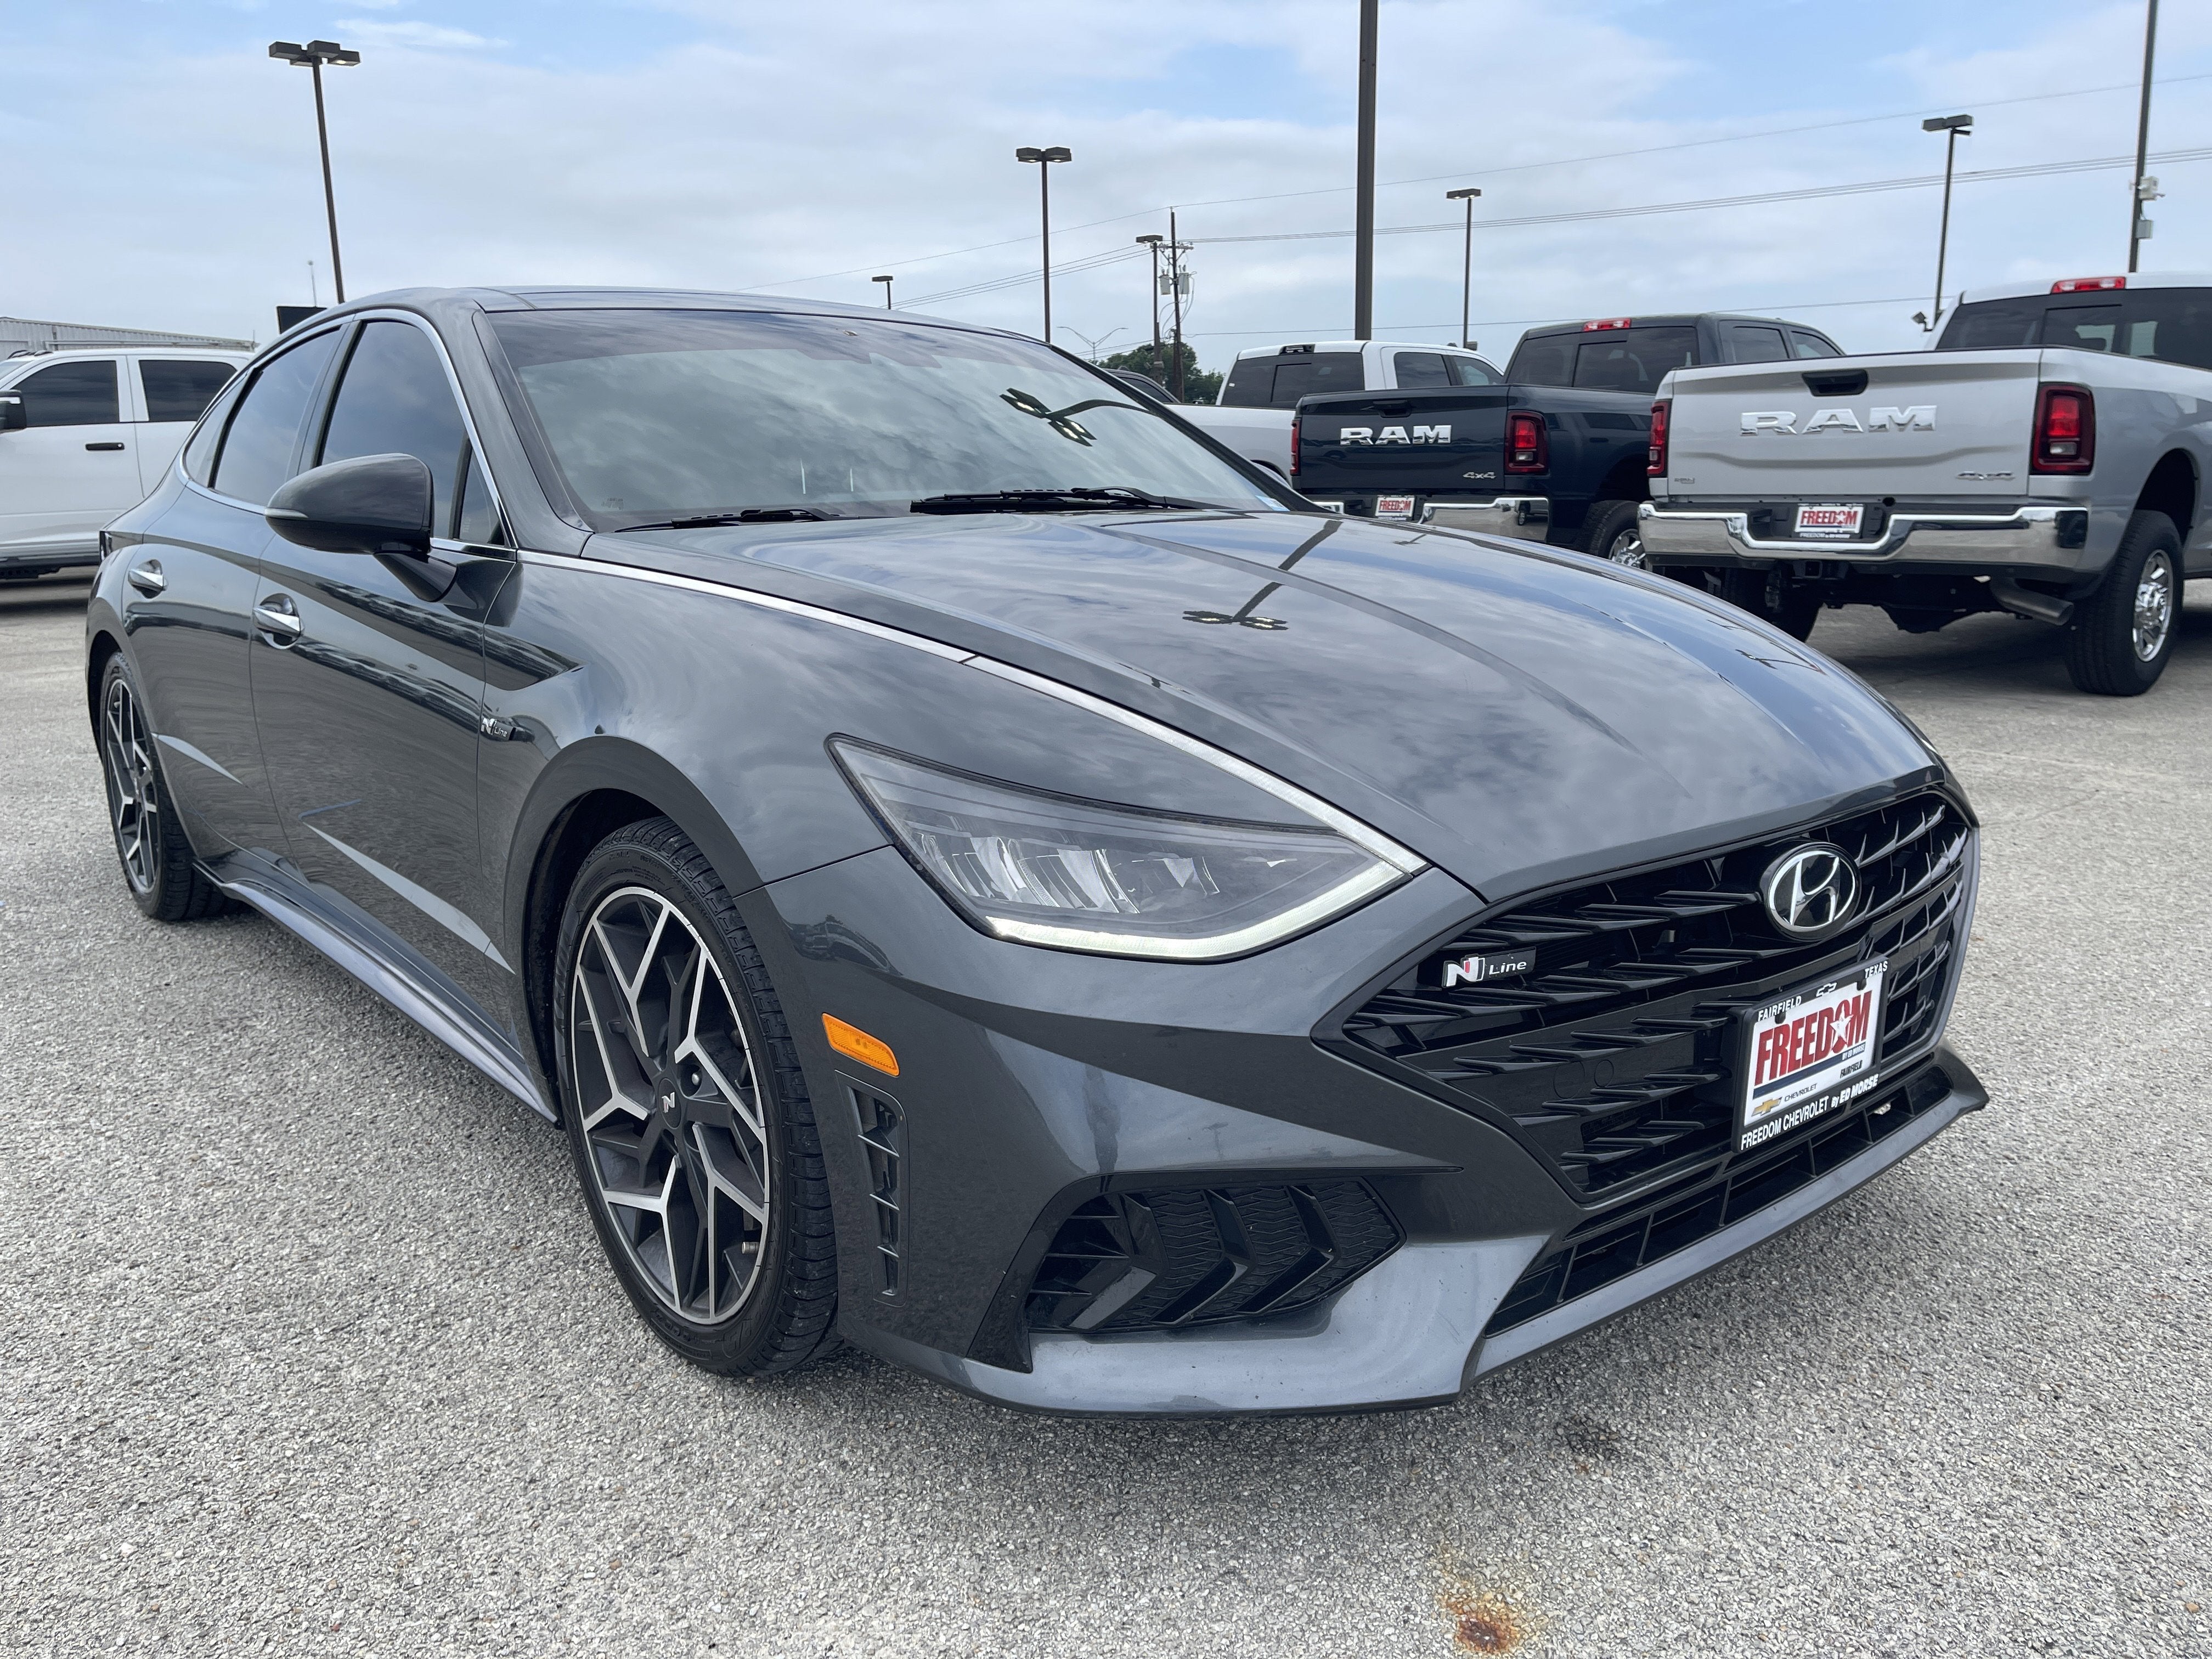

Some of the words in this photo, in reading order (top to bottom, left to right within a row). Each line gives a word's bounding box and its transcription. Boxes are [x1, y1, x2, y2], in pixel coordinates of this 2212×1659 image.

[1740, 405, 1937, 436] RAM
[1340, 425, 1452, 445] RAM
[1800, 511, 1858, 525] FREEDOM
[1489, 961, 1527, 975] Line
[1865, 961, 1888, 978] TEXAS
[1758, 996, 1802, 1022] FAIRFIELD
[1754, 990, 1872, 1086] FREEDOM
[1784, 1084, 1817, 1102] CHEVROLET
[1741, 1124, 1781, 1150] FREEDOM
[1782, 1096, 1829, 1131] CHEVROLET
[1839, 1087, 1850, 1103] ED
[1850, 1074, 1879, 1098] MORSE
